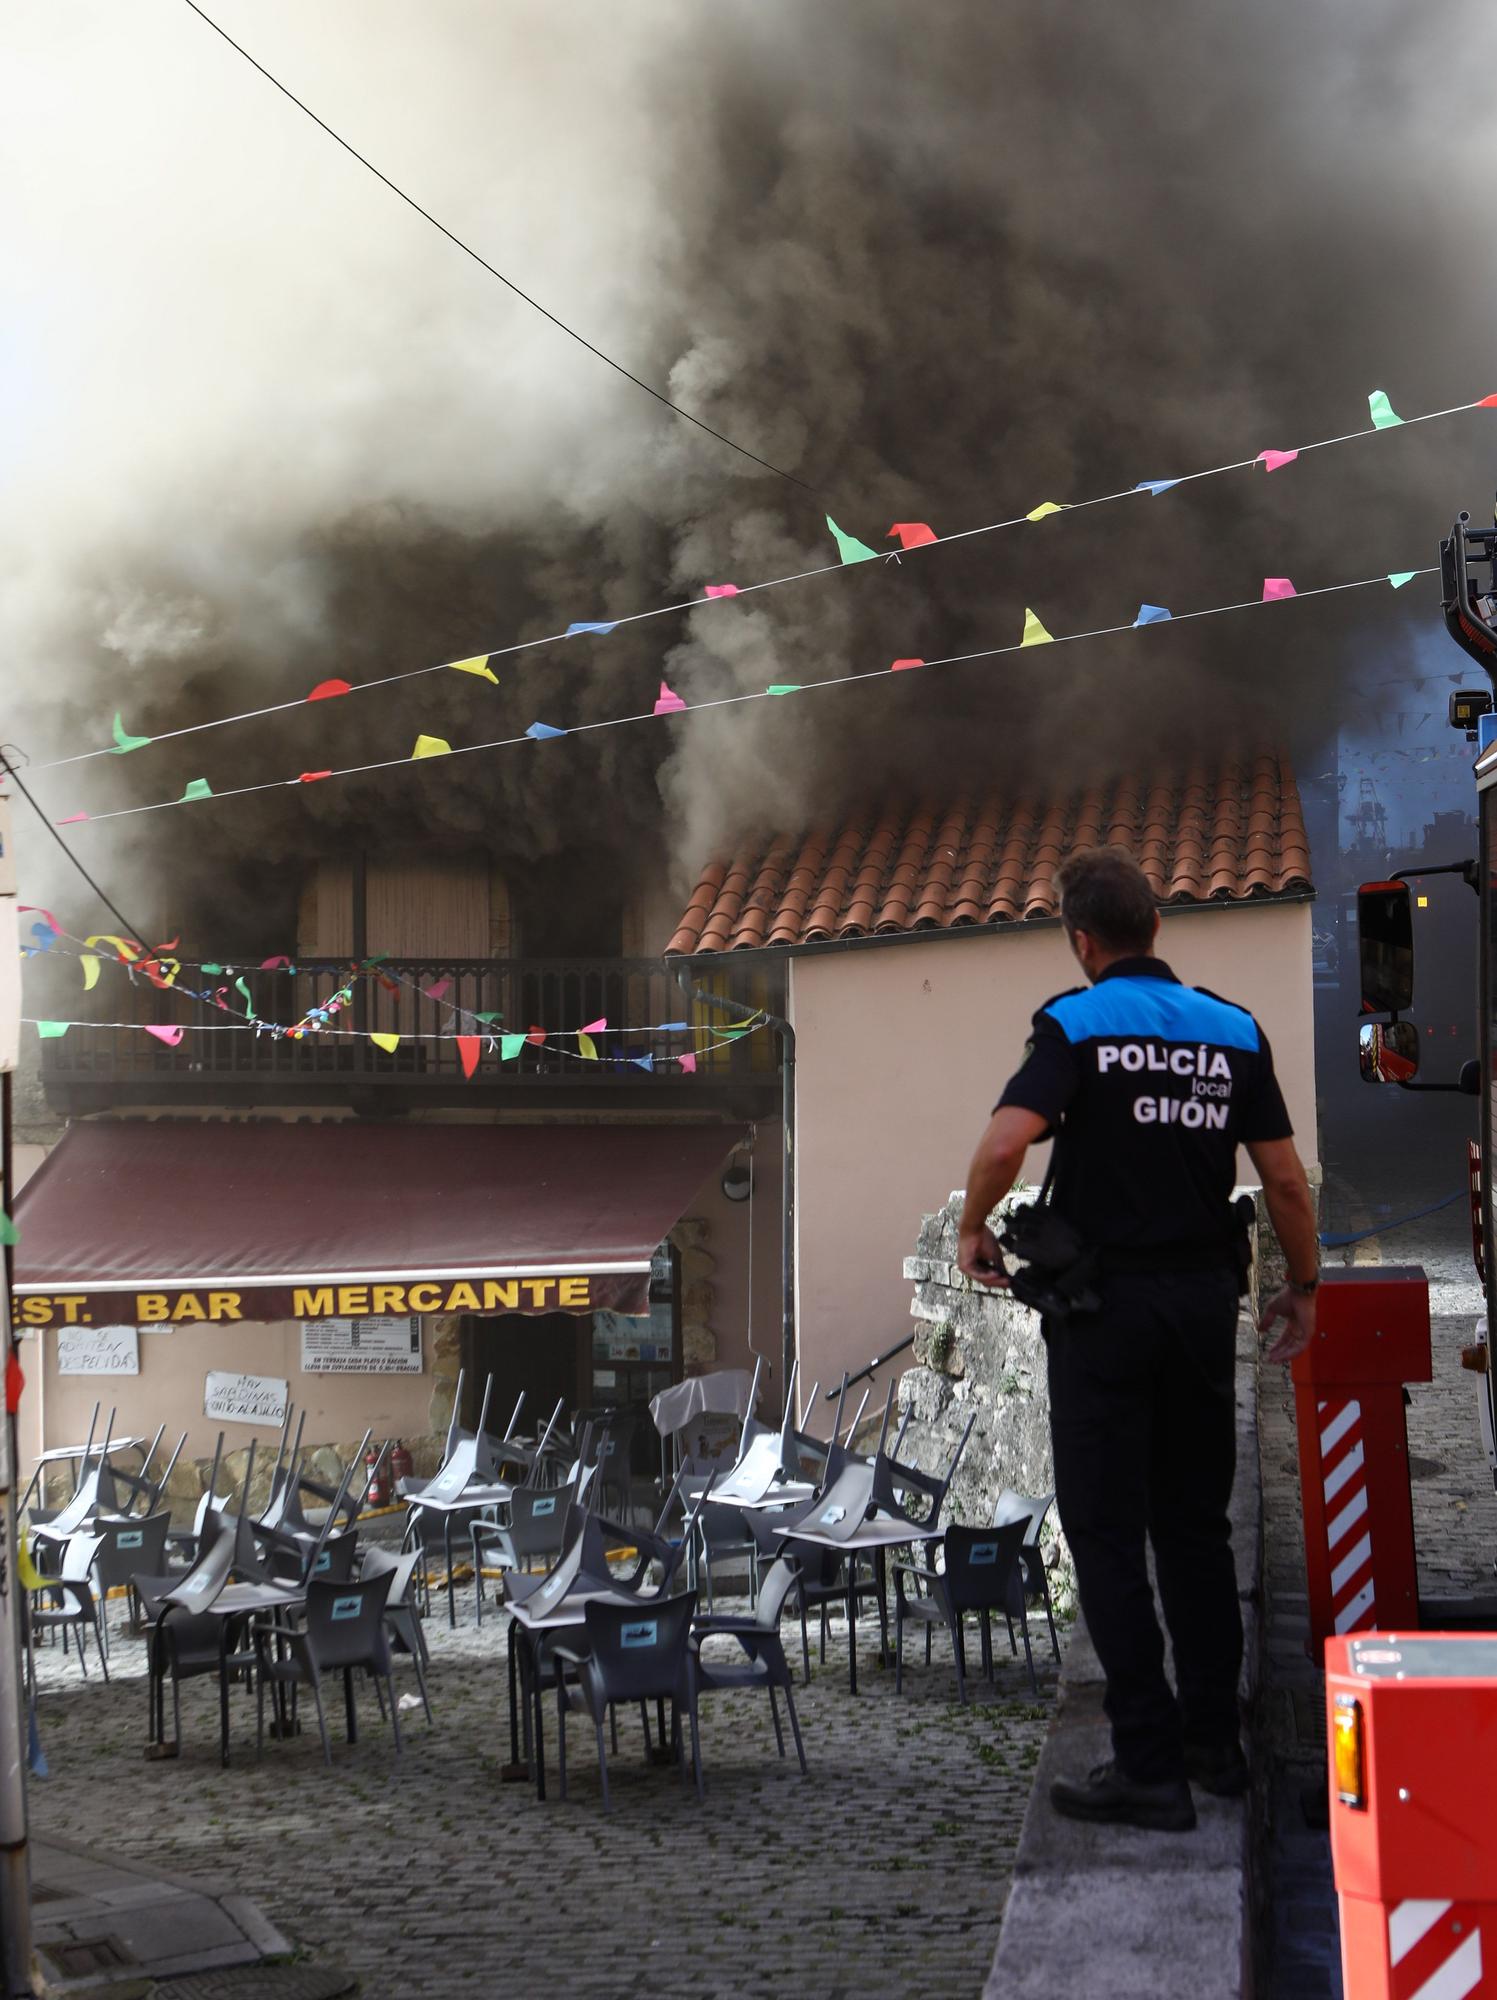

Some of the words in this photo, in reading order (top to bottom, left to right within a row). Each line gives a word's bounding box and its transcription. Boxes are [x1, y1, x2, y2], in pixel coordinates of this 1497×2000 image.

[1192, 1077, 1232, 1098] local
[13, 1296, 91, 1324] ST.
[136, 1291, 243, 1321] BAR
[292, 1278, 591, 1317] MERCANTE
[237, 1375, 261, 1388] HAY
